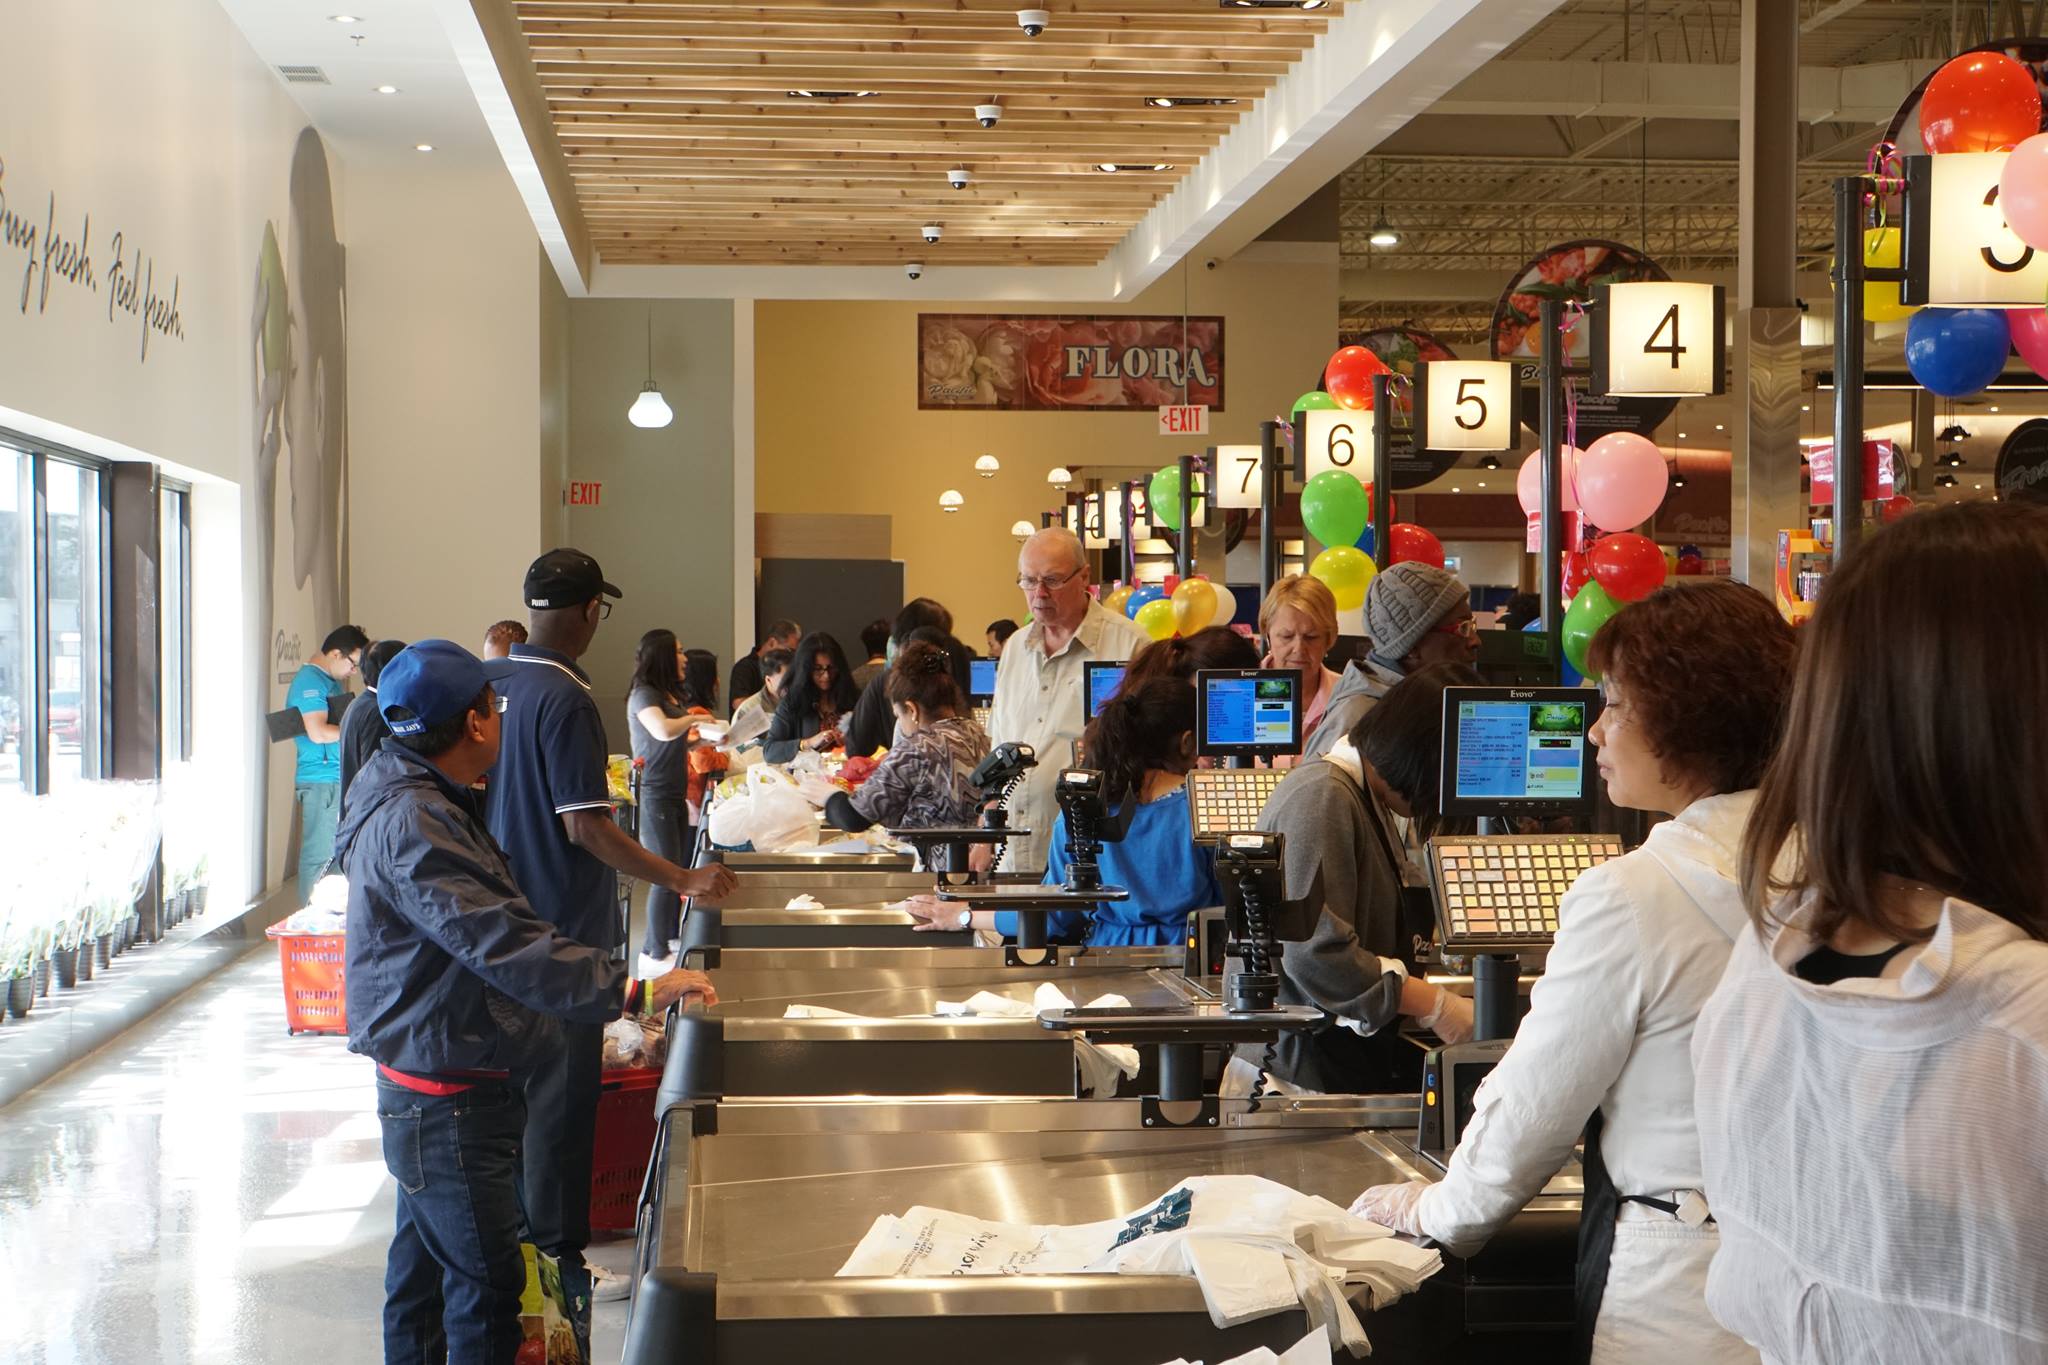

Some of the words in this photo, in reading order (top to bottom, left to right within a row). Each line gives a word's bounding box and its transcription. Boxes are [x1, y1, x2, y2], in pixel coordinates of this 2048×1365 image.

[40, 189, 97, 315] fresh.
[108, 231, 140, 323] Feel
[141, 257, 184, 363] fresh.
[1643, 304, 1688, 370] 4
[1064, 346, 1217, 387] FLORA
[1169, 407, 1202, 432] EXIT
[1454, 379, 1488, 431] 5
[1327, 424, 1355, 467] 6
[571, 482, 602, 505] EXIT
[1236, 458, 1259, 493] 7
